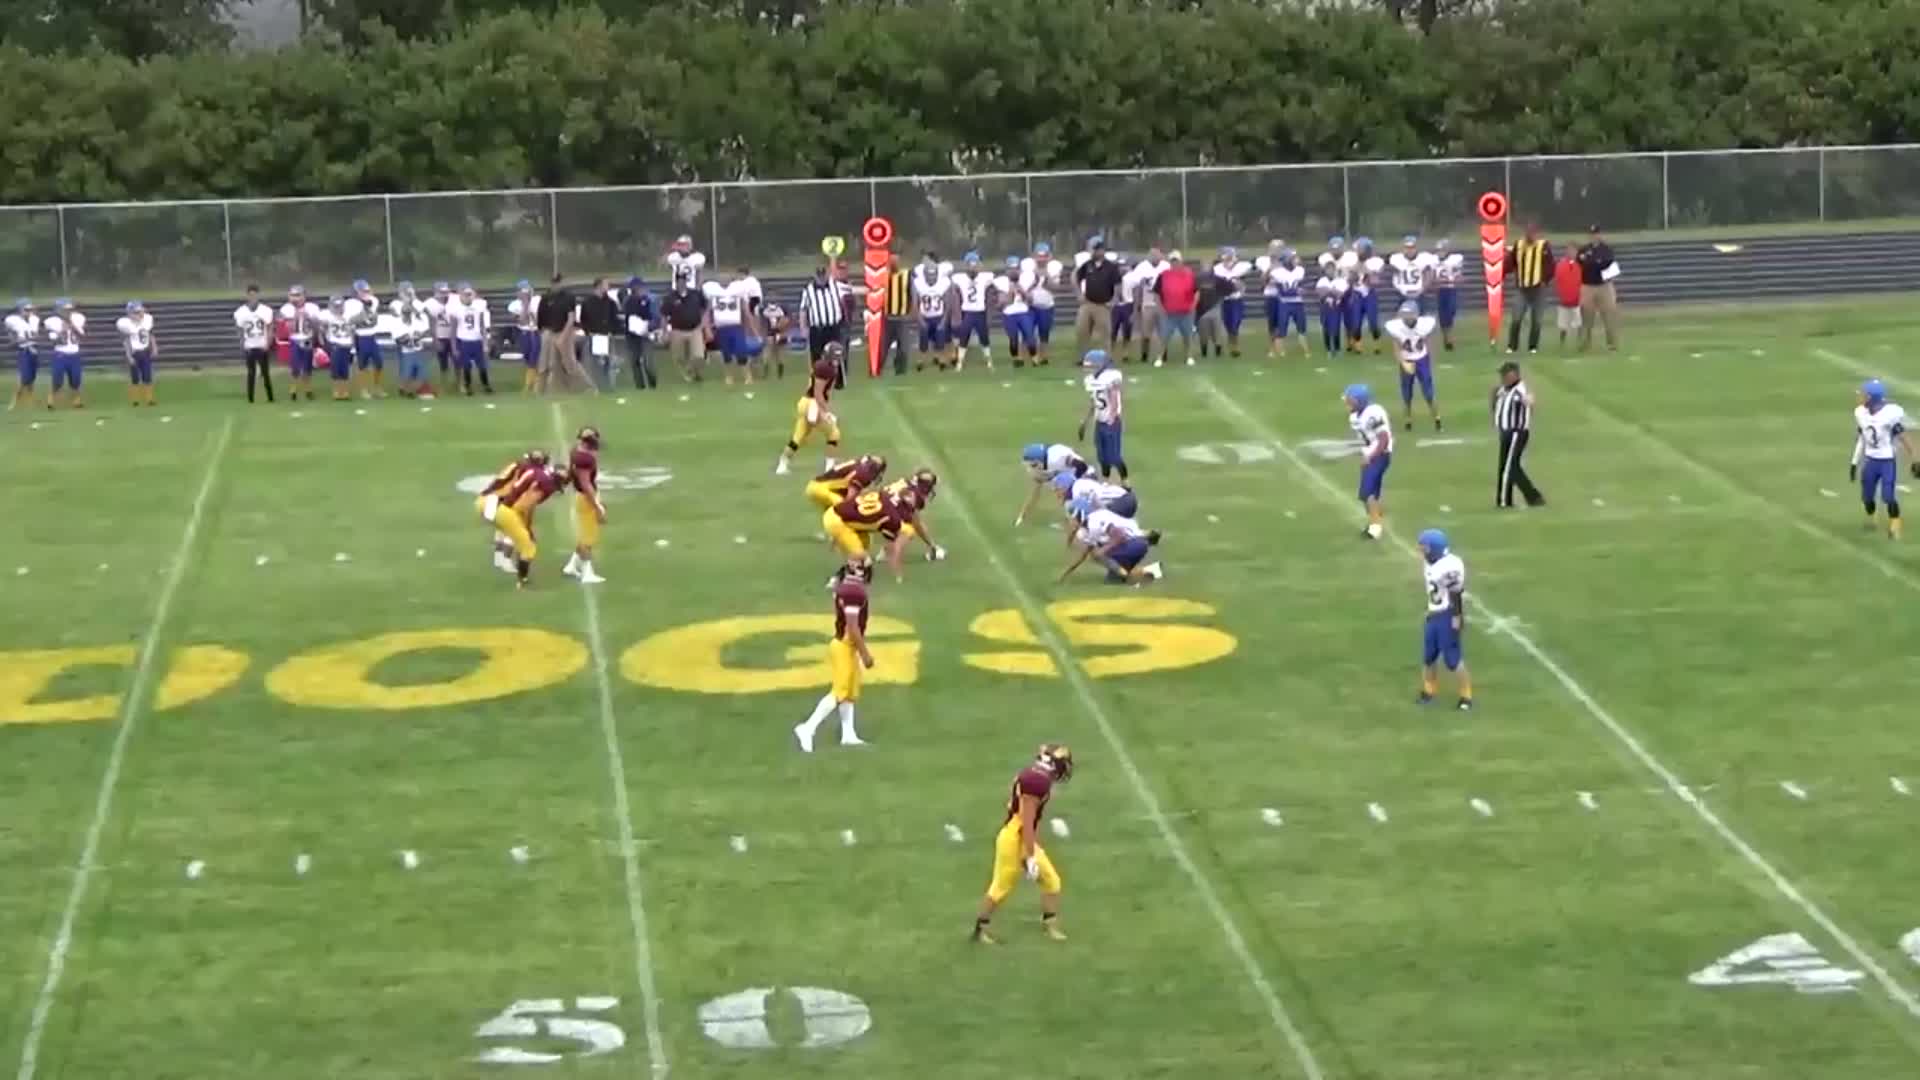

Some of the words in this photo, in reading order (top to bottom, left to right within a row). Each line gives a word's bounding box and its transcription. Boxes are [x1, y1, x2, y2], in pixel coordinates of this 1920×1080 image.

[828, 238, 838, 254] 2
[967, 286, 977, 304] 2
[464, 313, 475, 330] 9
[1401, 337, 1425, 354] 44
[474, 986, 872, 1064] 50
